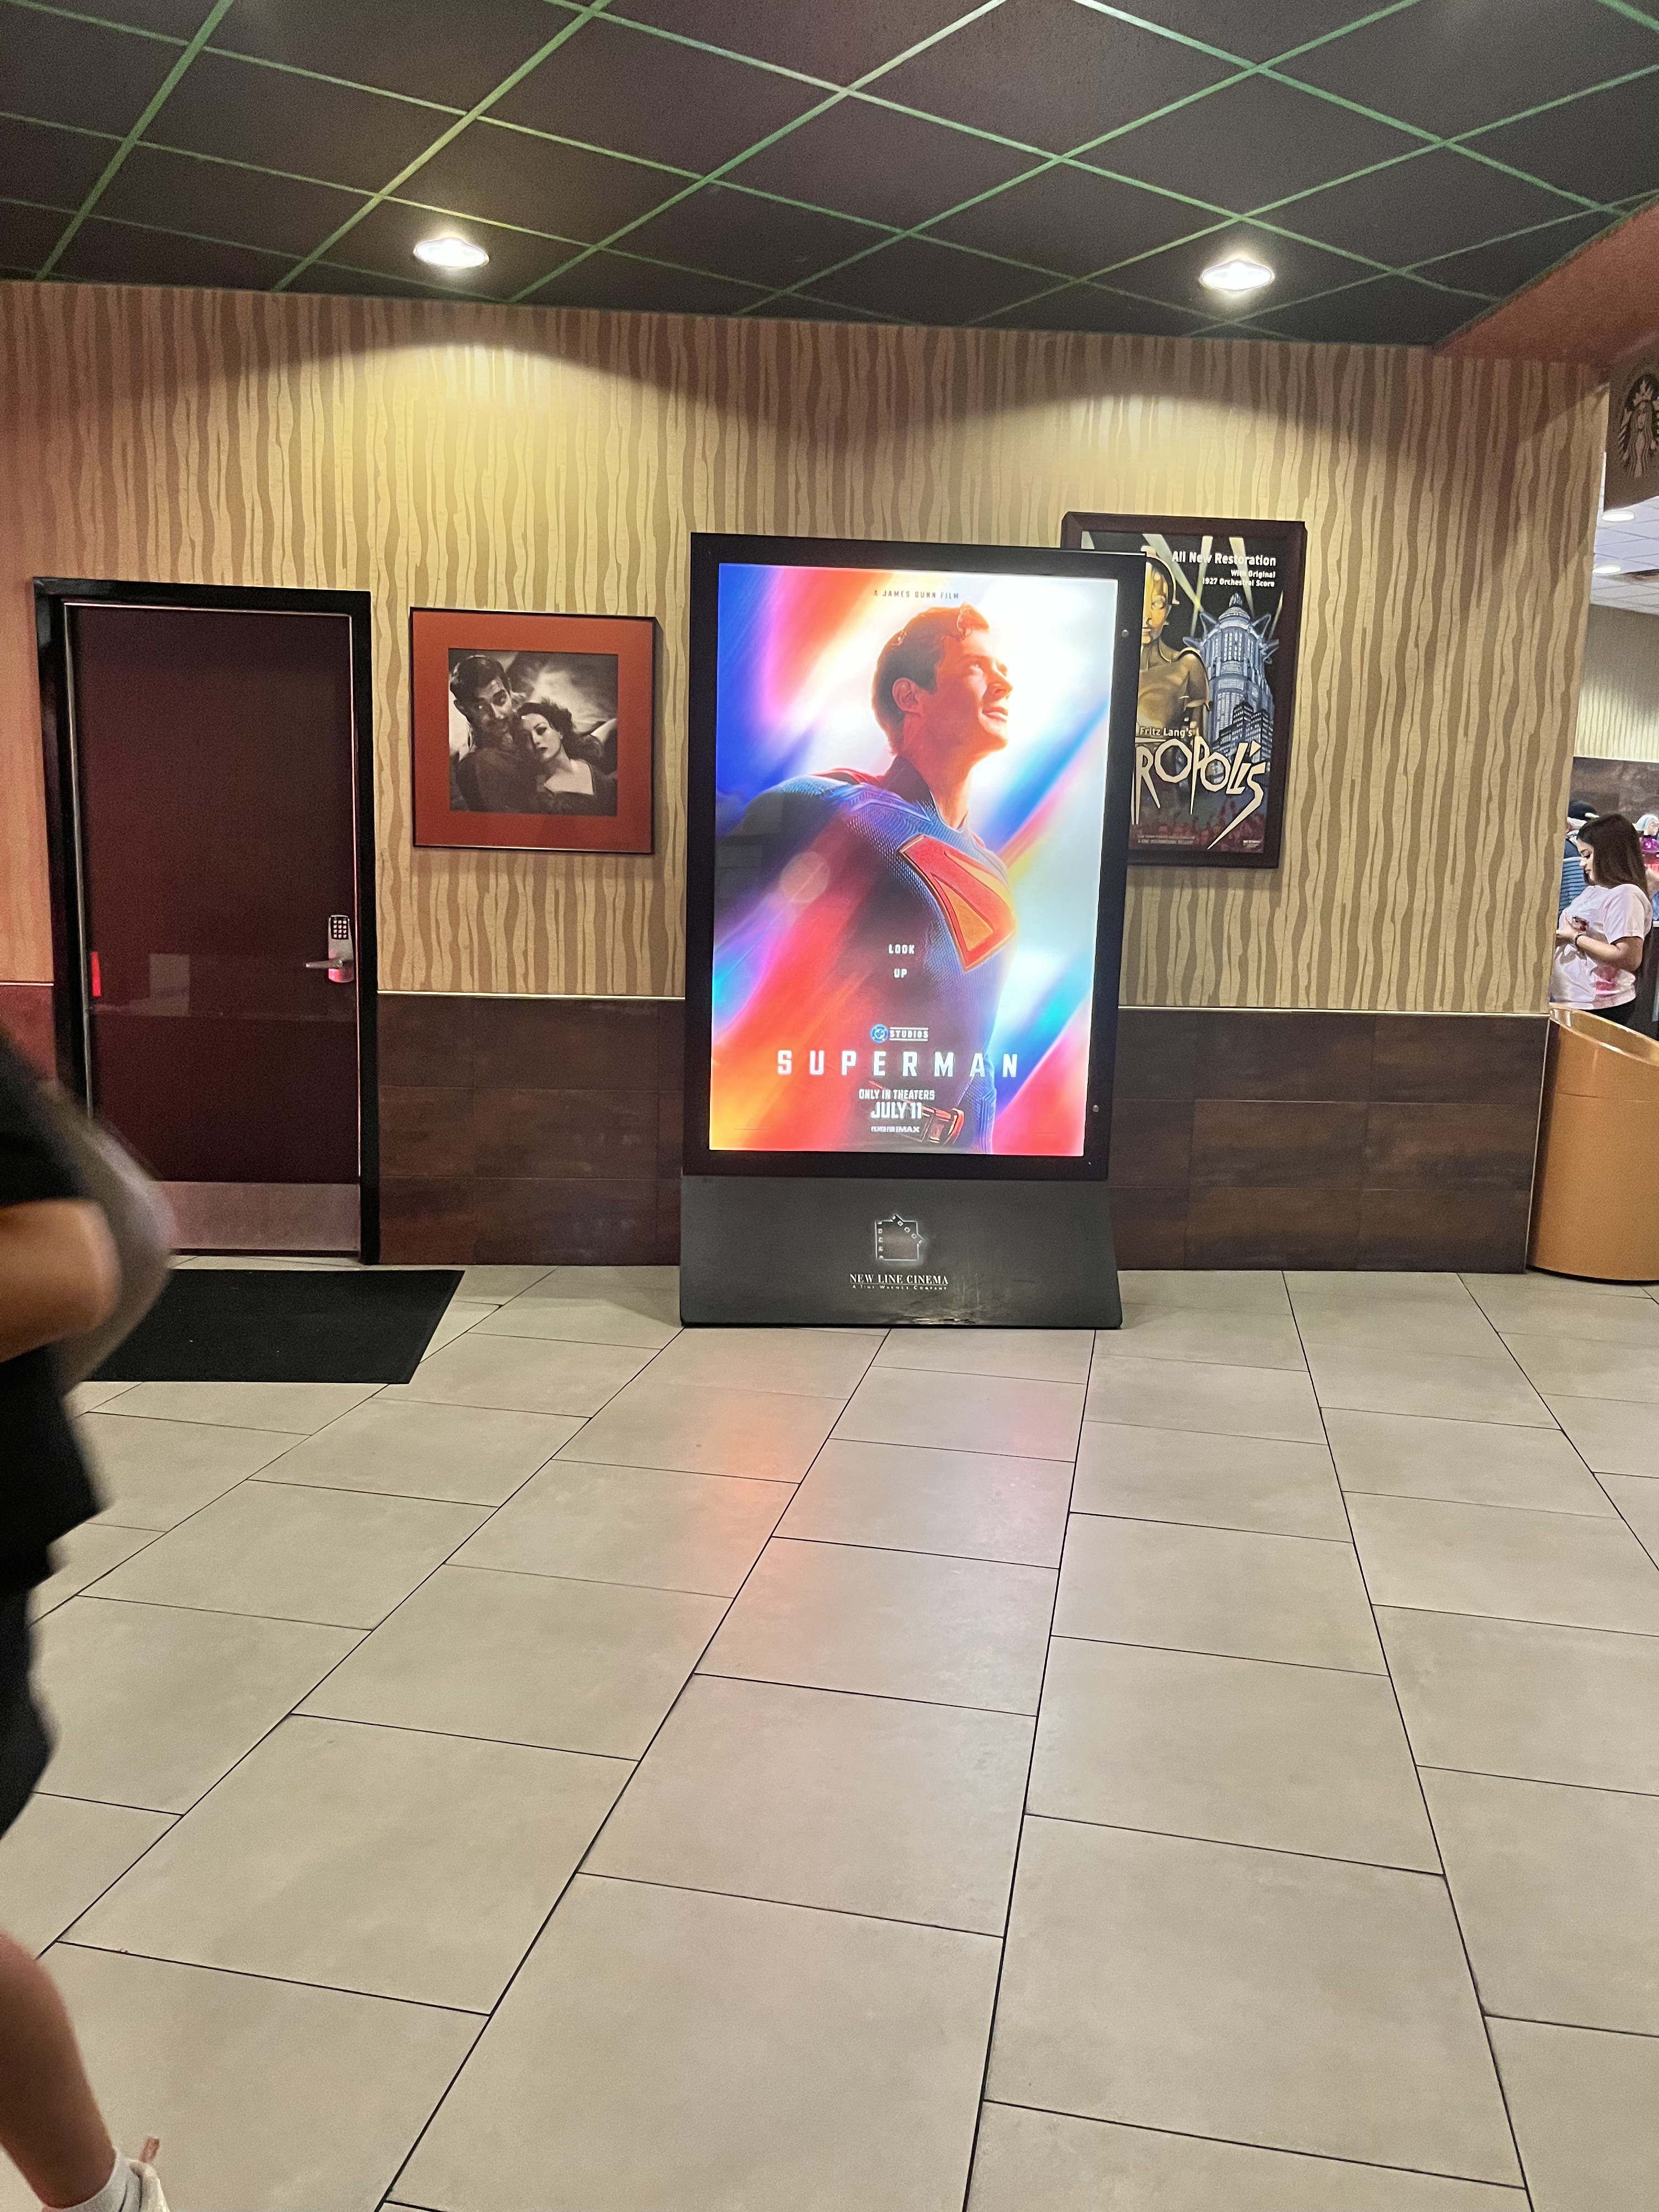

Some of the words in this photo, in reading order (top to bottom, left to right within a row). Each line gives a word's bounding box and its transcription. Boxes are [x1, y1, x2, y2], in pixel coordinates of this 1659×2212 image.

[1172, 551, 1186, 562] All
[1189, 552, 1212, 563] New
[1215, 552, 1276, 566] Restoration
[1248, 570, 1276, 579] Original
[1219, 578, 1254, 586] Orchestral
[1140, 727, 1161, 735] Fritz
[1164, 727, 1193, 738] Lang's
[888, 944, 915, 955] LOOK
[894, 968, 908, 978] UP
[889, 1030, 929, 1039] STUDIOS
[777, 1049, 1018, 1077] SUPERMAN
[859, 1088, 880, 1099] ONLY
[881, 1089, 891, 1099] IN
[893, 1089, 935, 1101] THEATERS
[870, 1101, 907, 1119] JULY
[910, 1102, 922, 1119] 11
[850, 1274, 873, 1283] NEW
[878, 1274, 903, 1284] LINE
[906, 1274, 949, 1284] CINEMA
